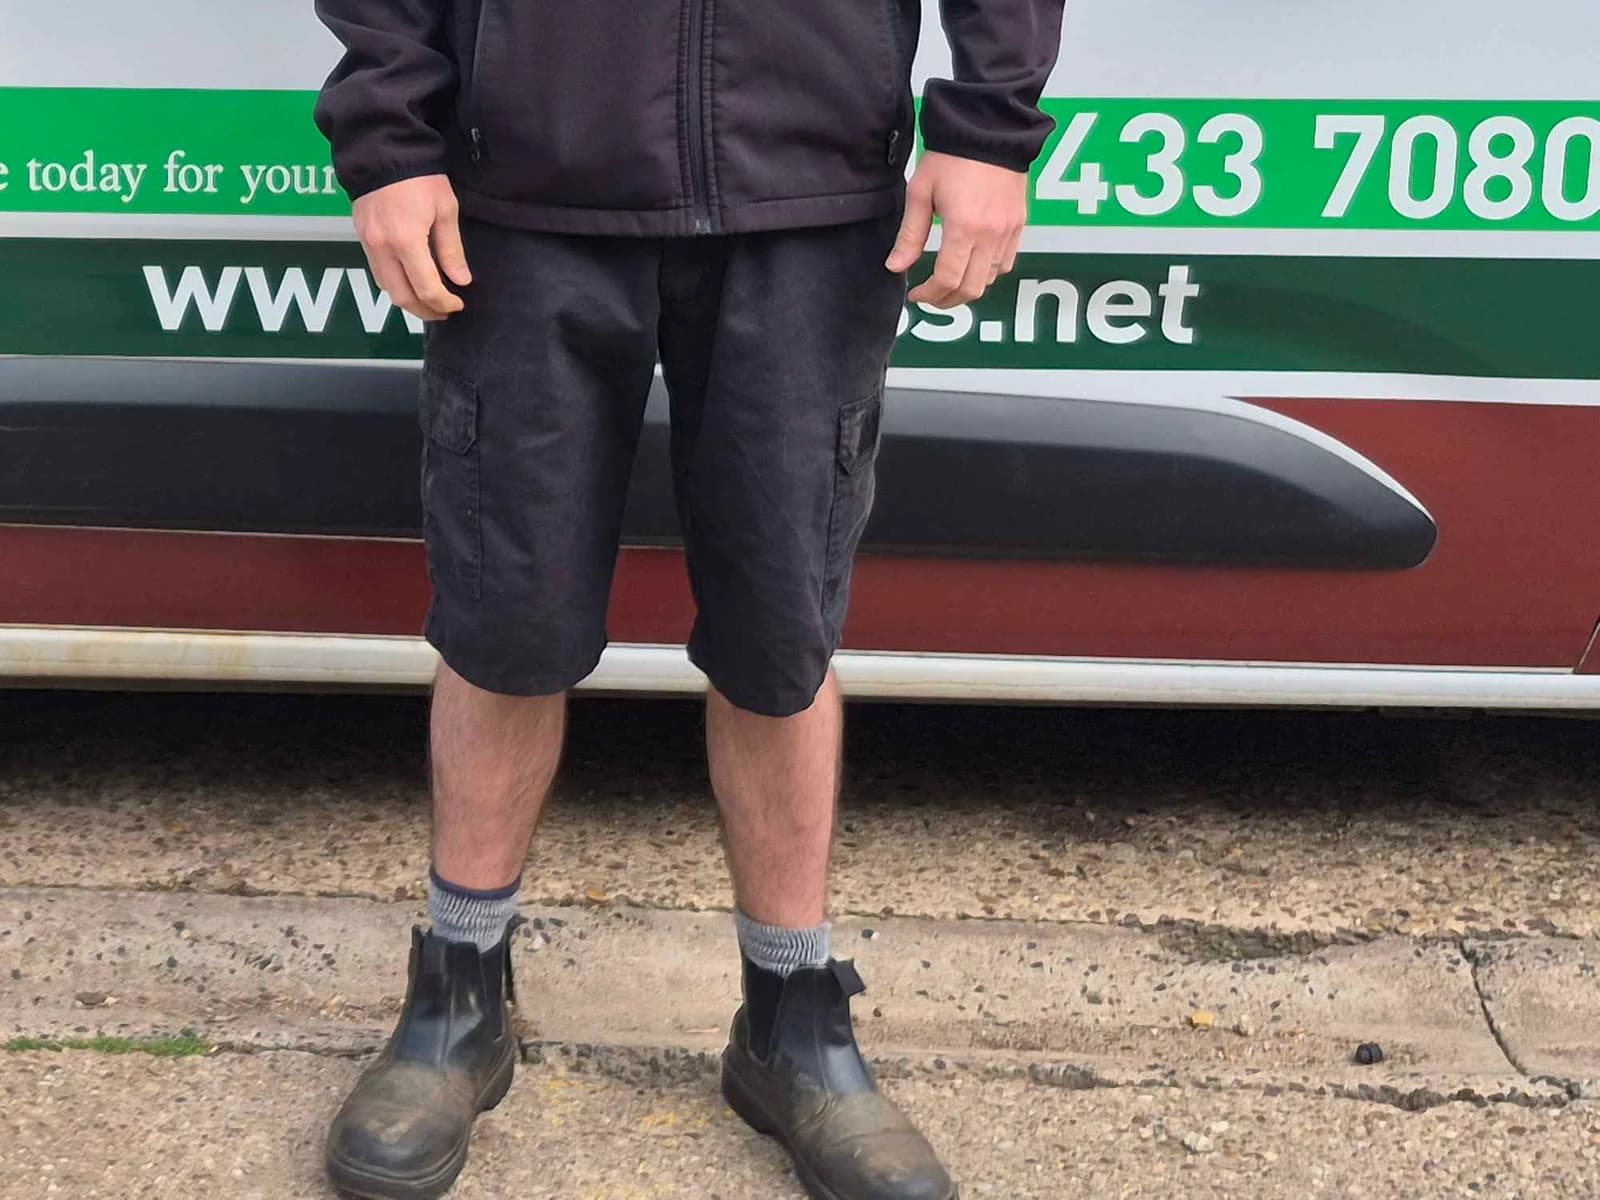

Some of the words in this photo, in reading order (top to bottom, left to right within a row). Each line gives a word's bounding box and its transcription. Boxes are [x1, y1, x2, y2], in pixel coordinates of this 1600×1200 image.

[27, 150, 147, 202] today
[163, 150, 224, 194] for
[239, 164, 336, 204] your
[1312, 113, 1600, 221] 7080
[896, 265, 1200, 344] s.net
